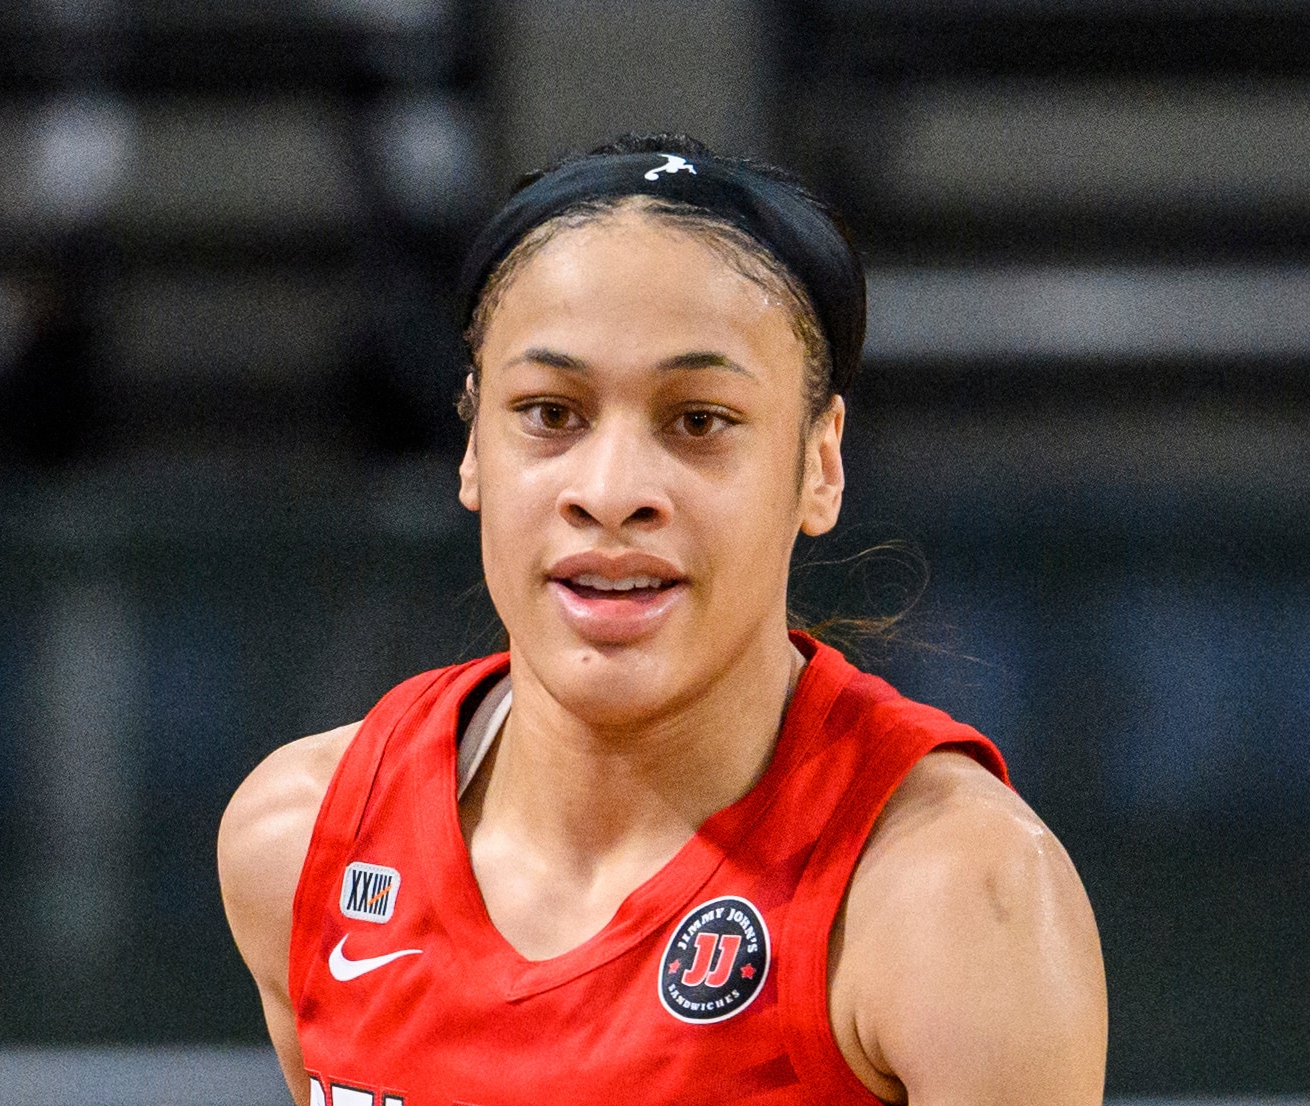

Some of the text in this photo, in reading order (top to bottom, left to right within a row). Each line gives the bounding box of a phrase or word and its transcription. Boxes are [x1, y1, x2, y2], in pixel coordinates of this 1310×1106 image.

[677, 907, 758, 953] JIMMY JOHN'S
[681, 932, 742, 988] JJ
[668, 983, 741, 1011] SANDWICHES
